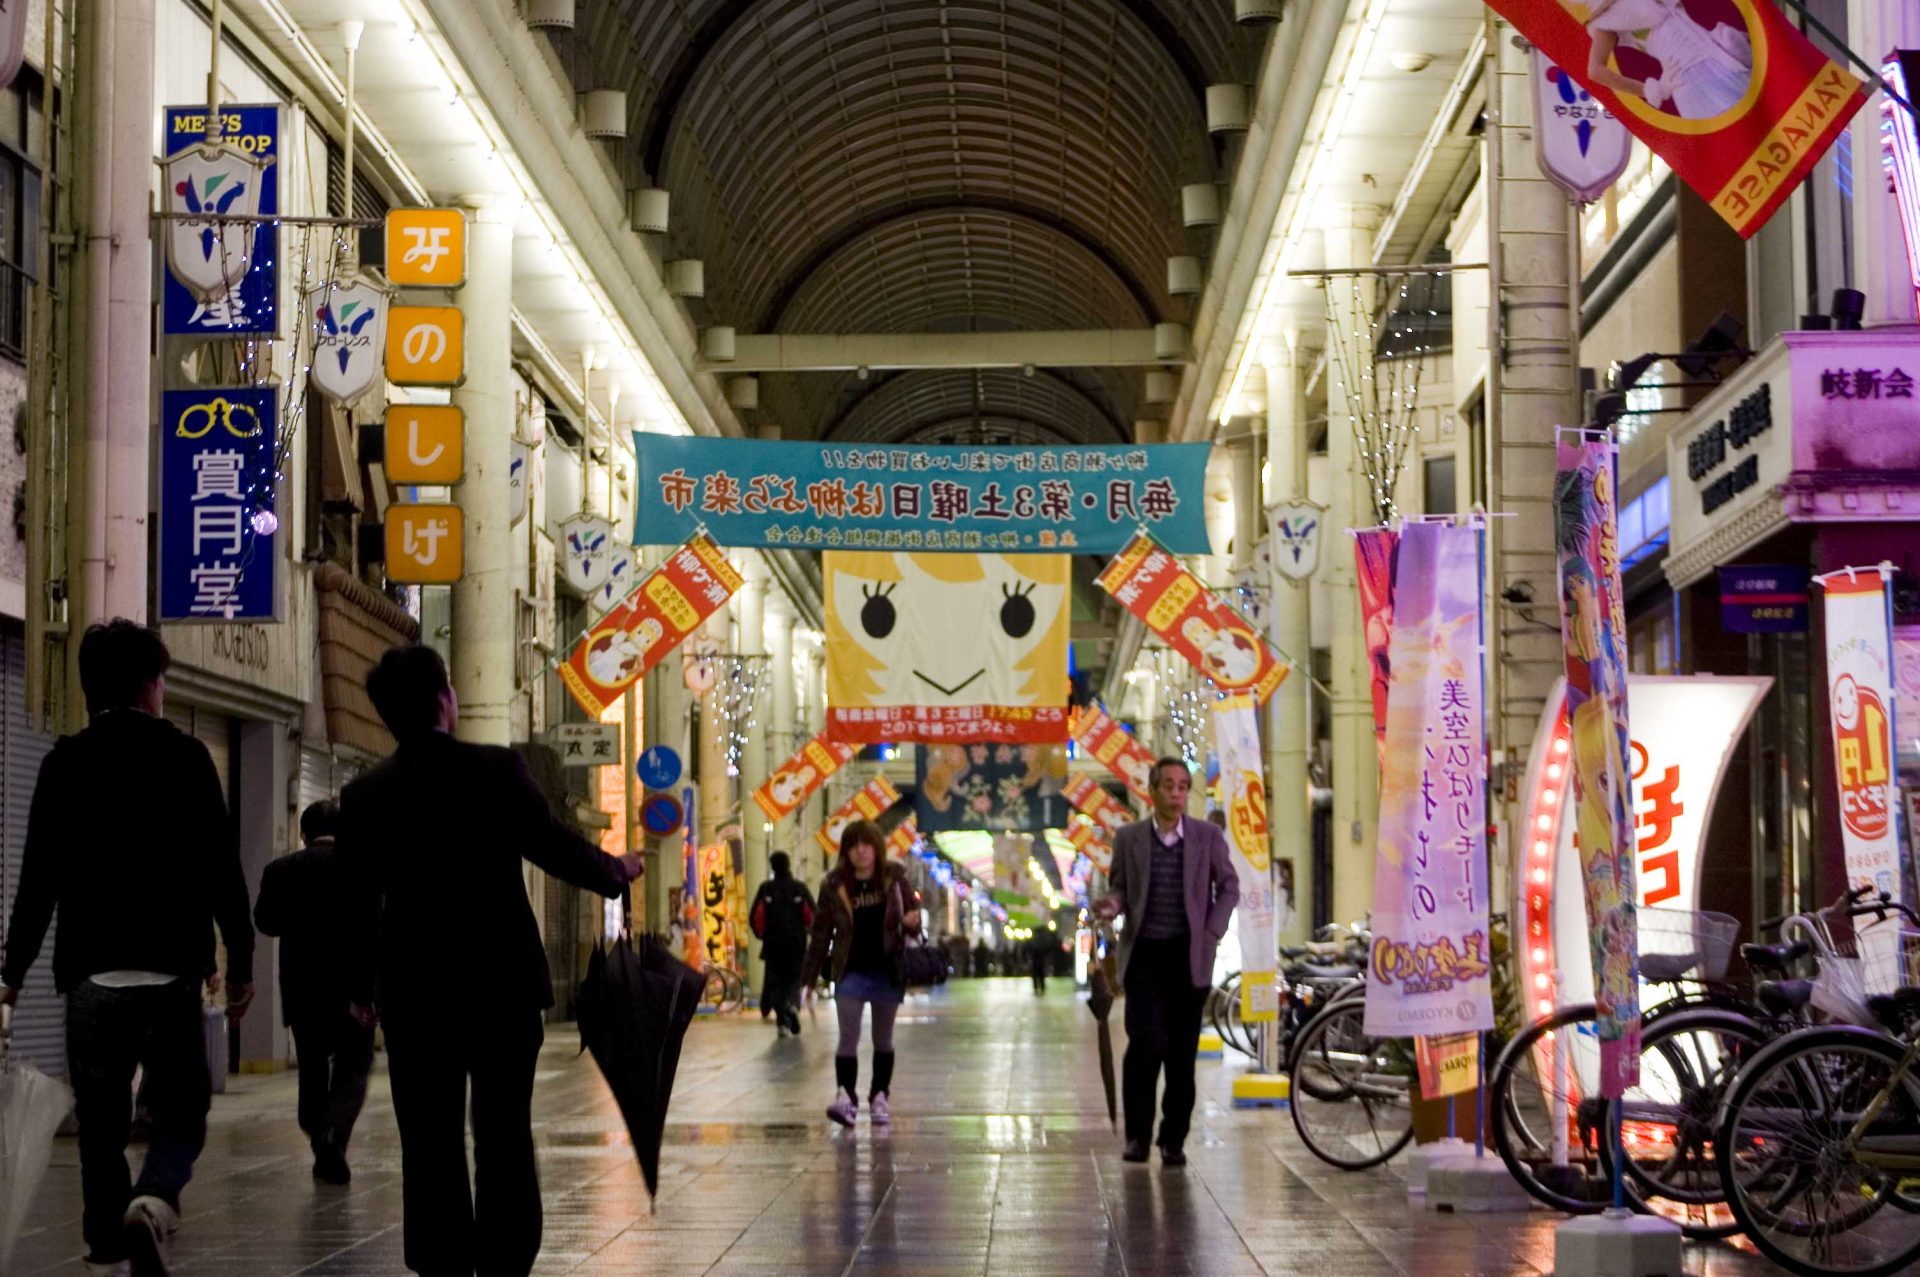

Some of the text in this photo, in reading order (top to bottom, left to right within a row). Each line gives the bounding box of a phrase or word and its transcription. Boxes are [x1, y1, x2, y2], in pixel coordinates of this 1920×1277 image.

[173, 114, 243, 133] ME'S
[221, 135, 272, 153] HOP
[317, 337, 371, 346] フローレンス
[402, 227, 451, 566] みのしげ
[190, 448, 246, 614] 賞月堂
